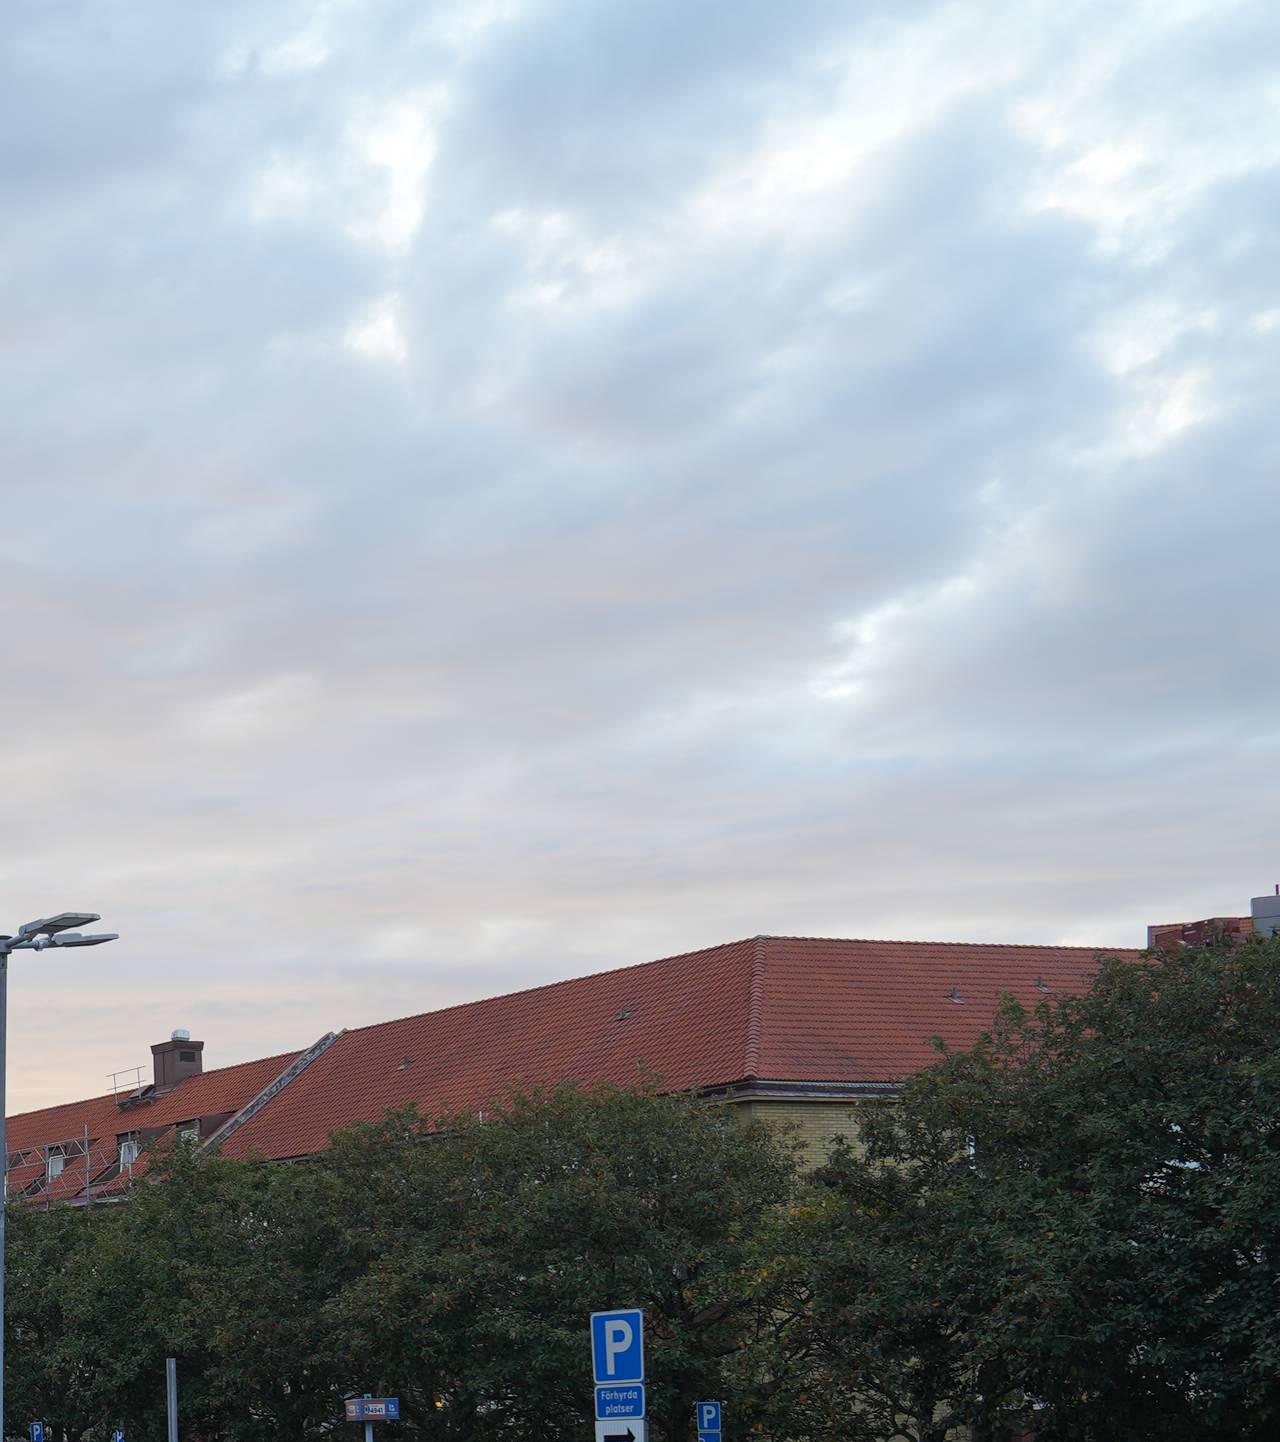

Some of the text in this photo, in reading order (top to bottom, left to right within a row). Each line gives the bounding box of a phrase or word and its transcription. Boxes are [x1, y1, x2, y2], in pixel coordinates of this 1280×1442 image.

[605, 1319, 633, 1376] P
[601, 1389, 638, 1403] Förhyrda
[605, 1404, 634, 1415] platser
[703, 1405, 716, 1428] P
